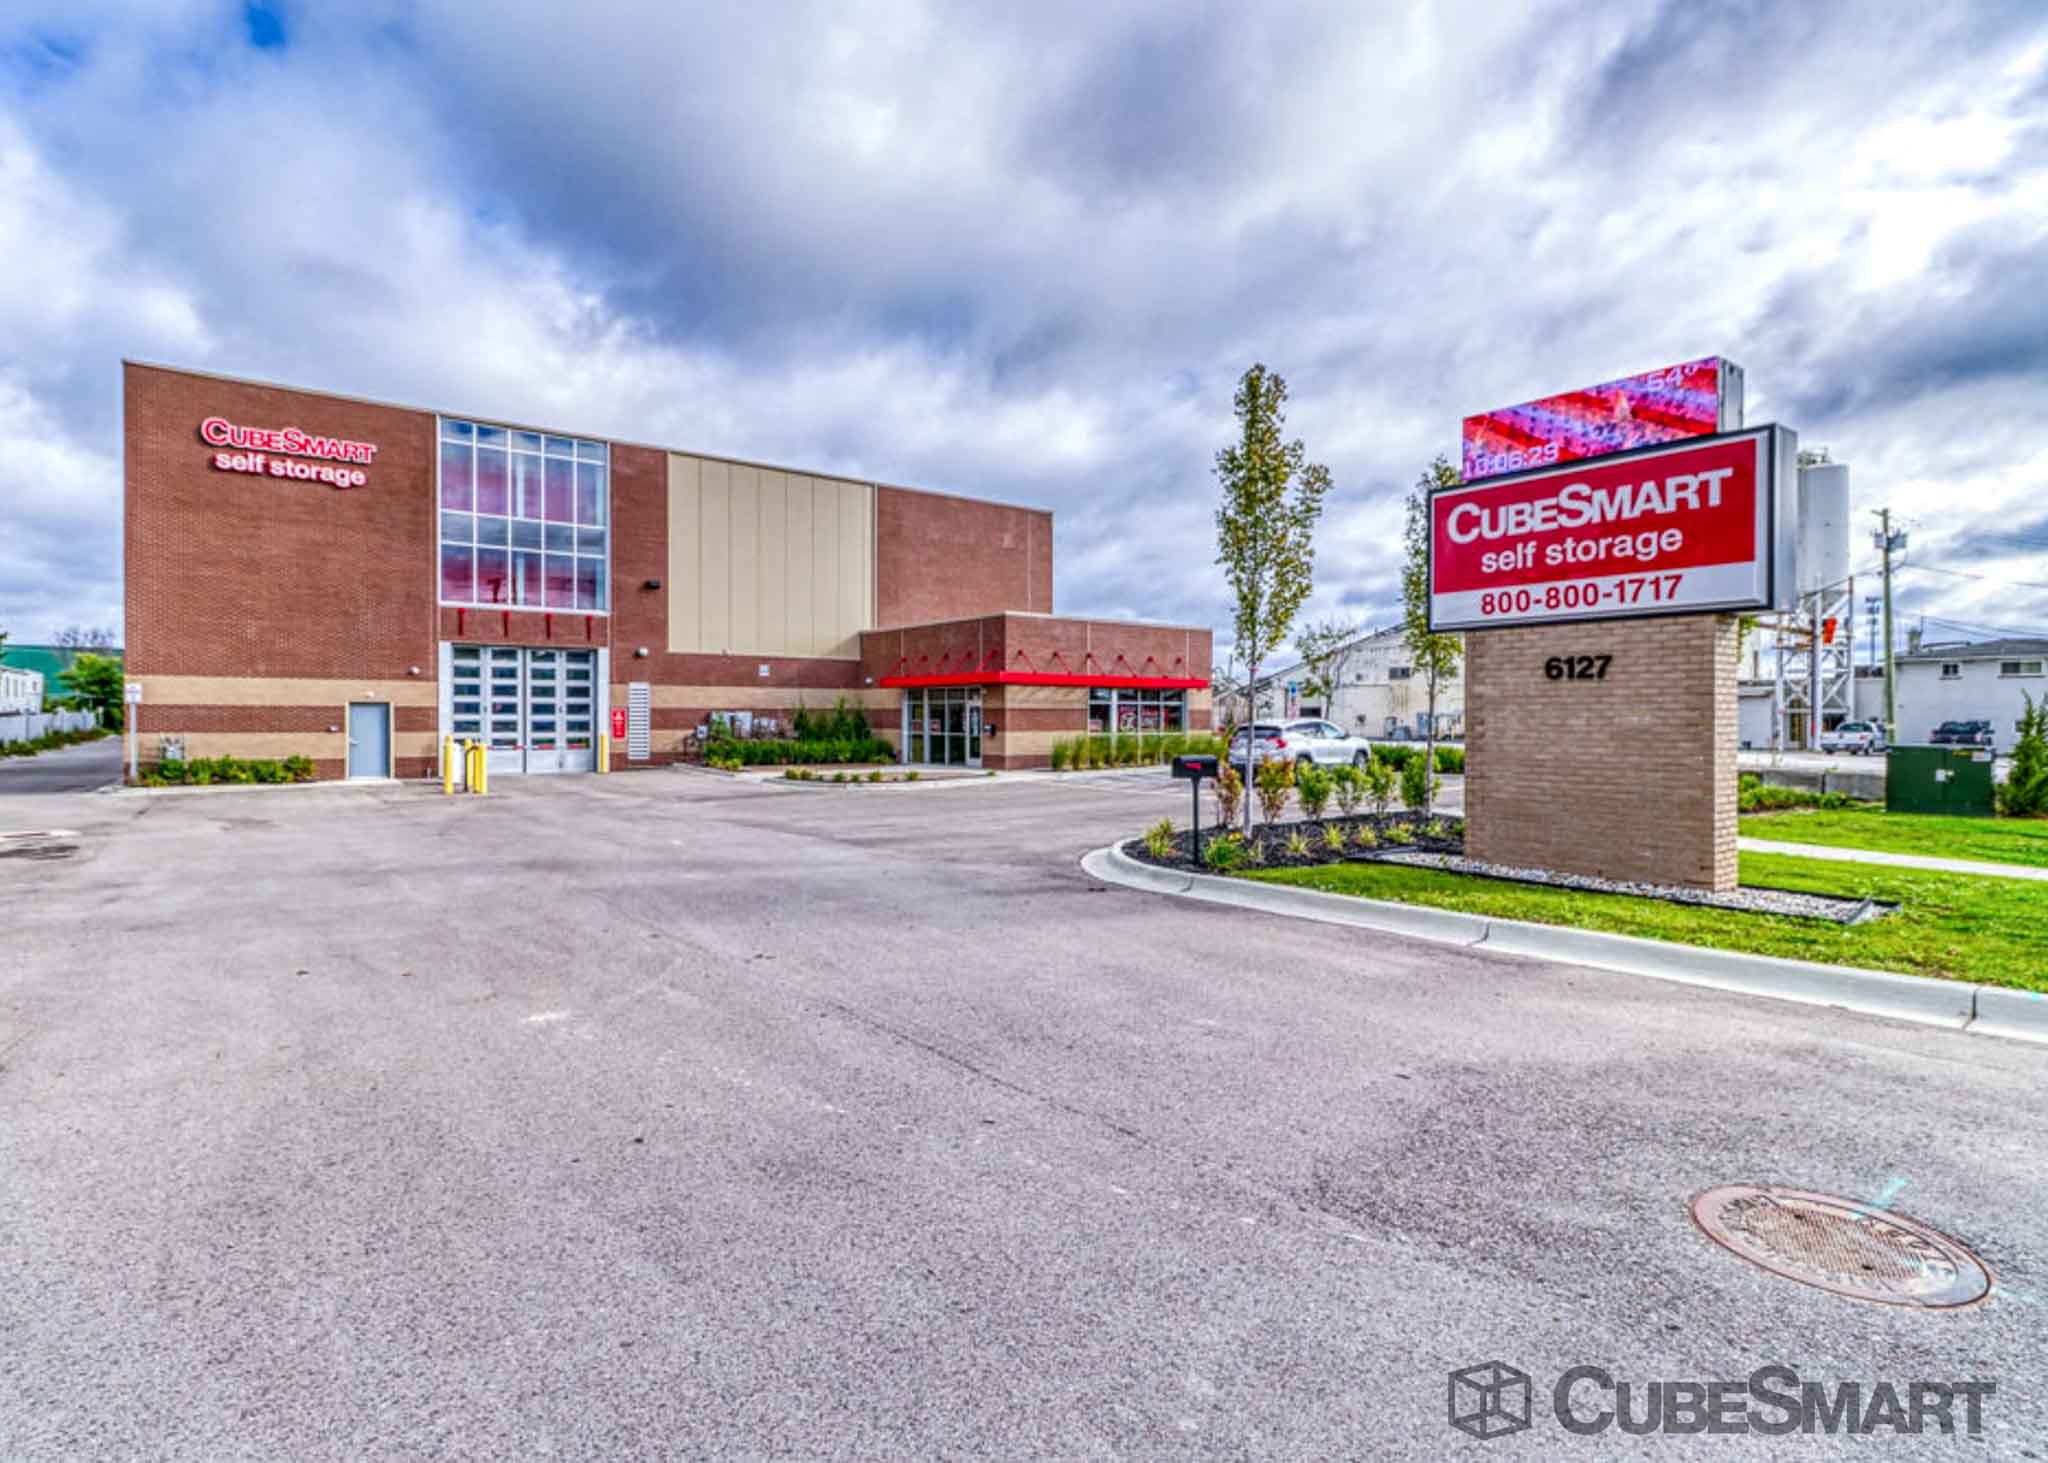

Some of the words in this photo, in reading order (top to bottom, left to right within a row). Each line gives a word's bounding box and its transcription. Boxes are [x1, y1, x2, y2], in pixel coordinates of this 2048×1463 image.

[214, 452, 265, 473] self
[270, 458, 366, 488] storage
[1481, 541, 1538, 573] self
[1544, 528, 1683, 563] storage
[1481, 574, 1683, 615] 800-800-1717
[1545, 655, 1613, 681] 6127
